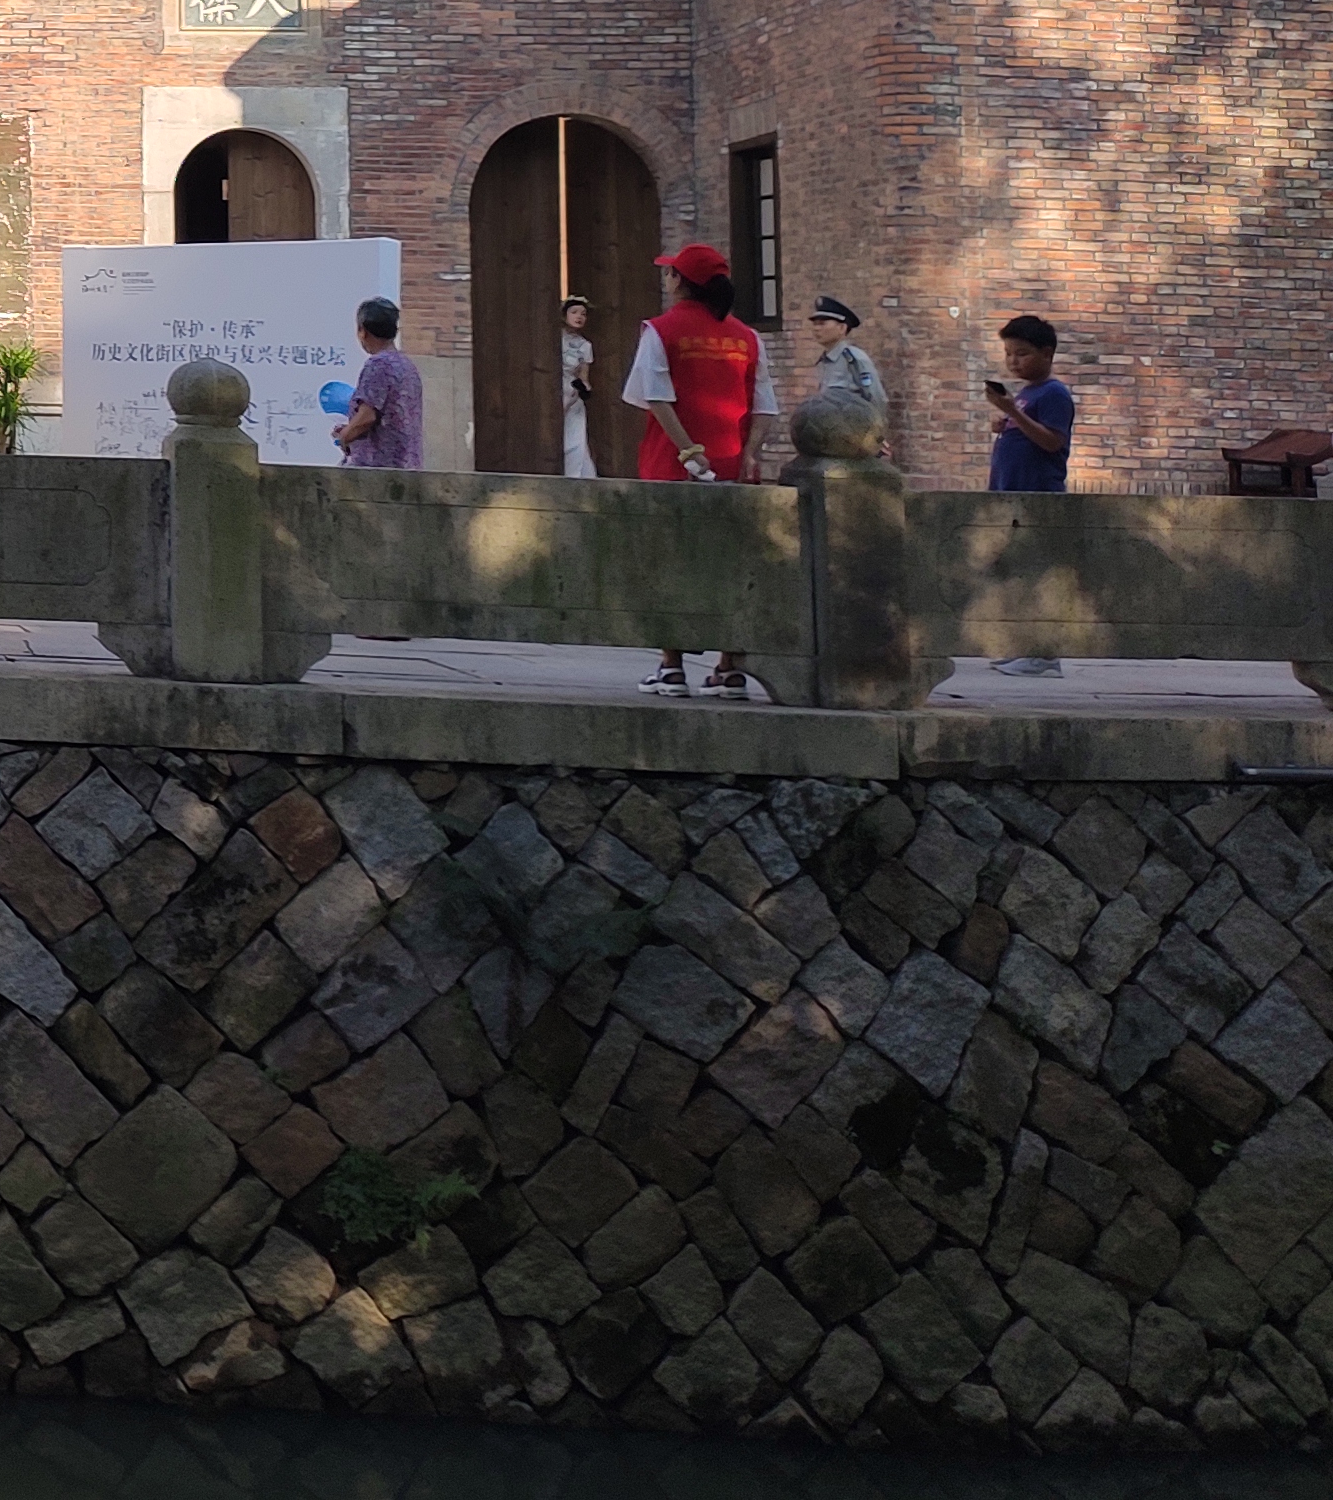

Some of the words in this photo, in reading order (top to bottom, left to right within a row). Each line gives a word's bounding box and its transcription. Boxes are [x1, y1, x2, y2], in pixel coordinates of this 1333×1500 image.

[92, 342, 347, 368] 历史文化街区保护与复兴专题论坛
